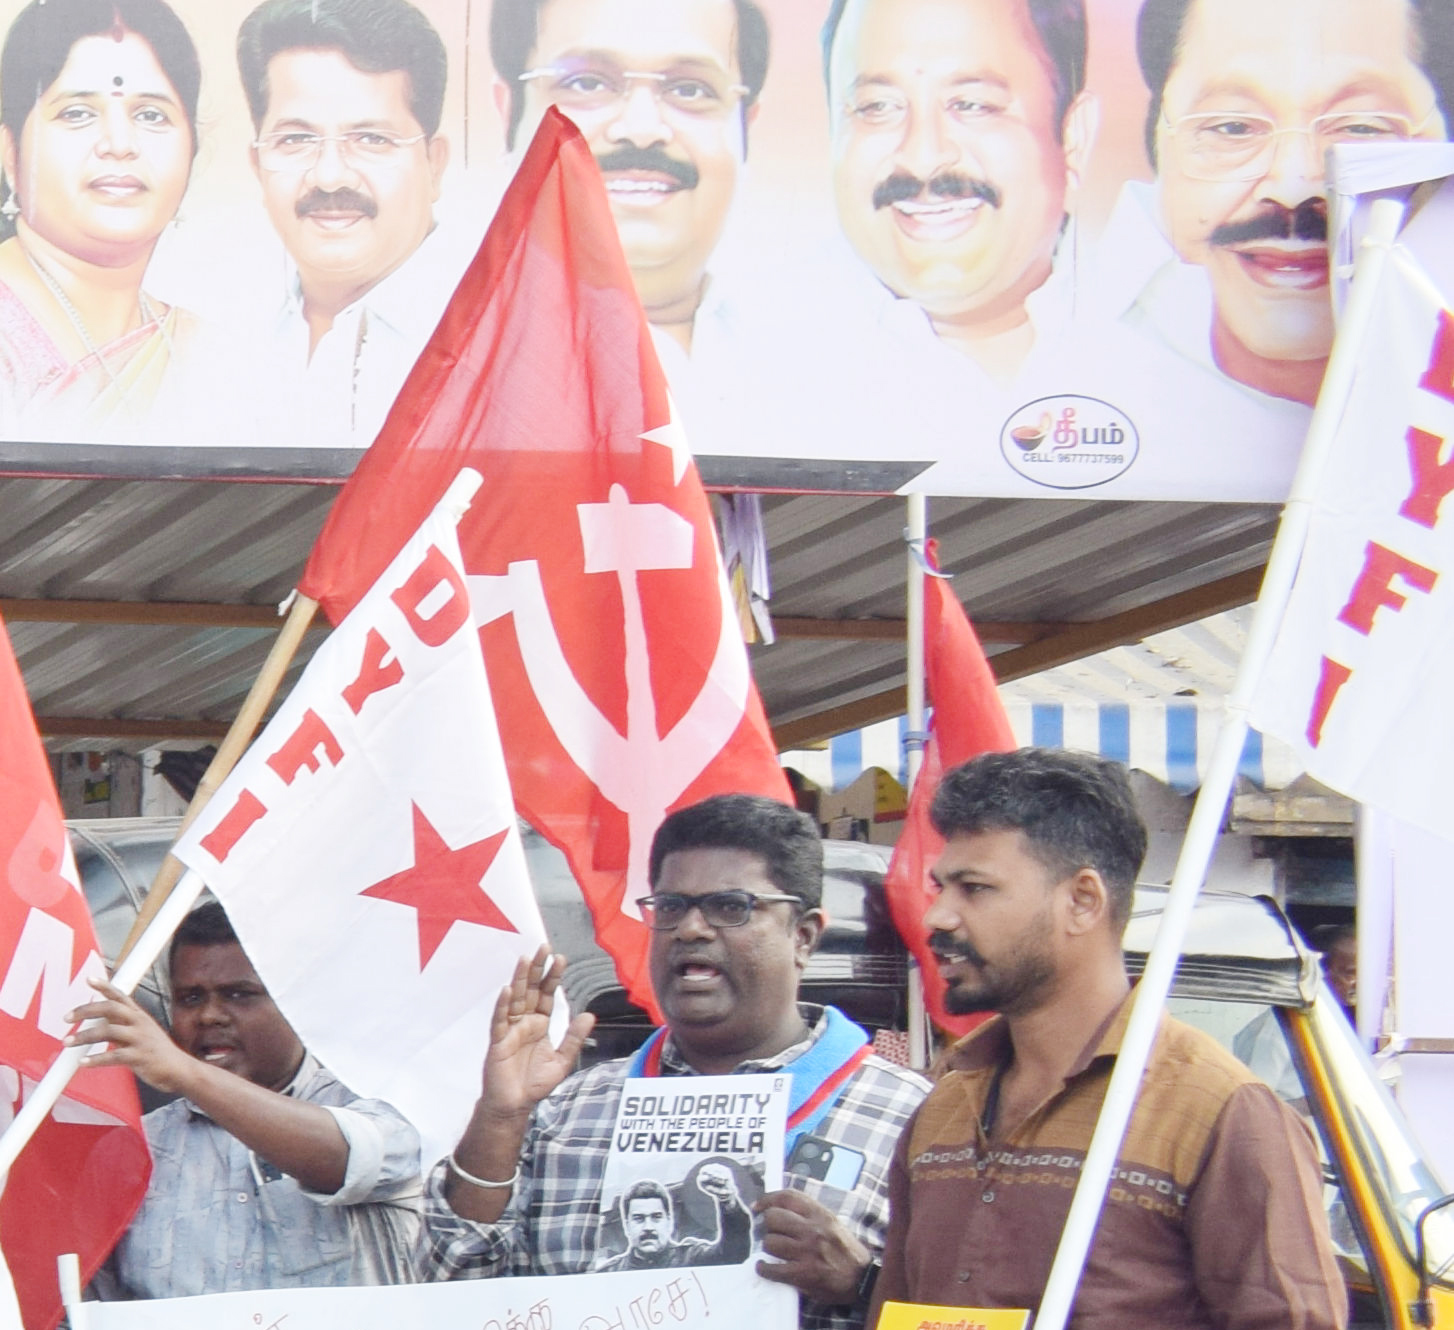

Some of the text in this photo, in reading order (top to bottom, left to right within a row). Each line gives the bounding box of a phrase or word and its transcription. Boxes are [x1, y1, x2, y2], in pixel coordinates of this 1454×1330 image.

[1052, 407, 1125, 452] தீபம்
[200, 543, 472, 864] DYFI
[624, 1093, 771, 1117] SOLIDARITY
[621, 1116, 767, 1130] WITH THE PEOPLE OF
[617, 1132, 765, 1153] VENEZUELA
